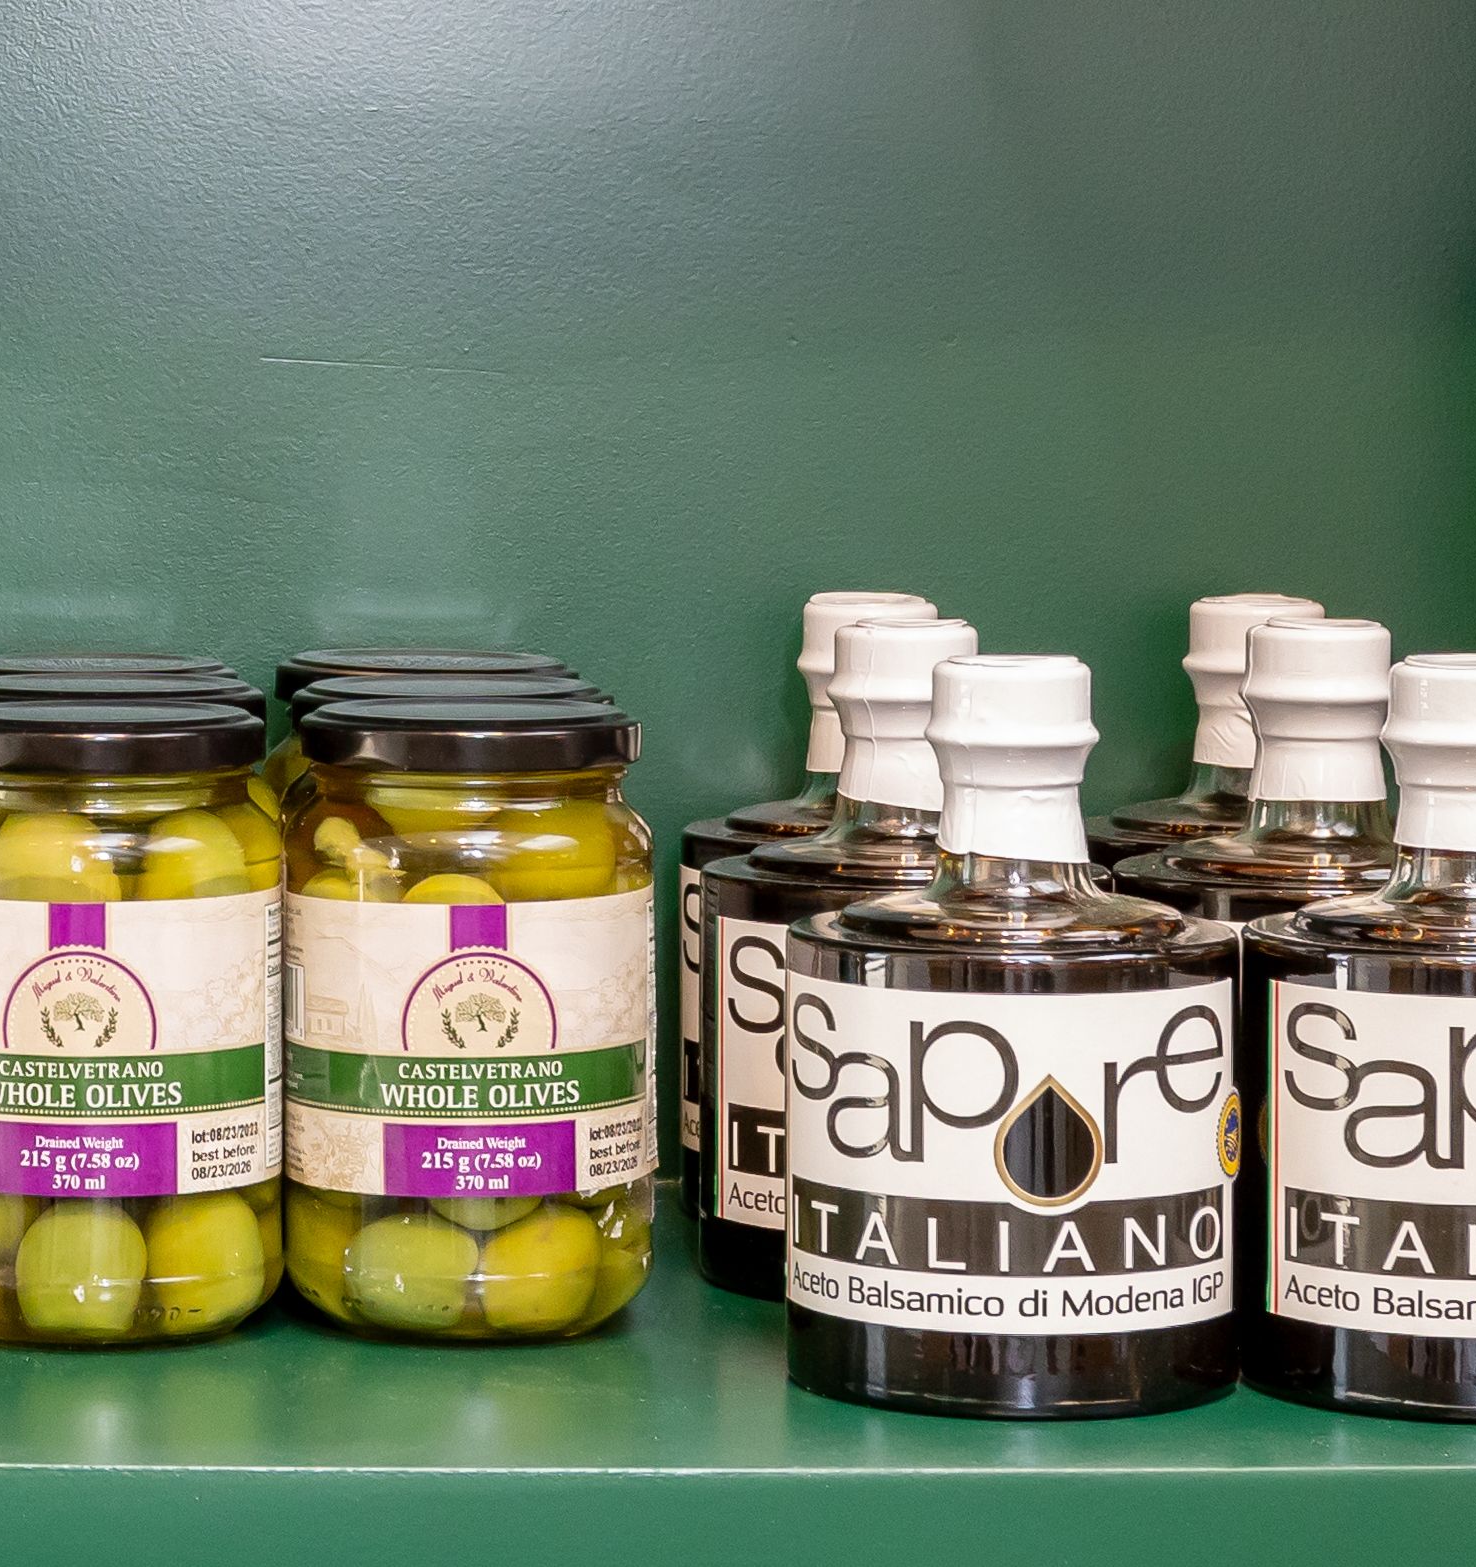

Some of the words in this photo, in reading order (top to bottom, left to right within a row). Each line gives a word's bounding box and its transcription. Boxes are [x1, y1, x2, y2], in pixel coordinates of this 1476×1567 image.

[0, 1060, 163, 1079] CASTELVETRANO
[398, 1060, 562, 1080] CASTELVETRANO
[86, 1082, 182, 1107] OLIVES
[381, 1082, 478, 1108] WHOLE
[489, 1081, 580, 1107] OLIVES
[35, 1136, 80, 1148] Drained
[83, 1137, 123, 1151] Weight
[21, 1150, 51, 1168] 215
[56, 1154, 66, 1172] g
[70, 1152, 110, 1170] (7.58
[115, 1153, 139, 1170] oz)
[192, 1149, 220, 1163] best
[191, 1160, 252, 1180] 08/23/2026
[52, 1175, 80, 1190] 370
[84, 1175, 105, 1190] ml
[793, 1190, 1222, 1272] ITALIANO
[793, 1266, 839, 1299] Aceto
[850, 1277, 1004, 1317] Balsamico
[1019, 1286, 1047, 1317] di
[1062, 1283, 1184, 1318] Modena
[1193, 1271, 1224, 1304] IGP
[1285, 1279, 1360, 1311] Aceto
